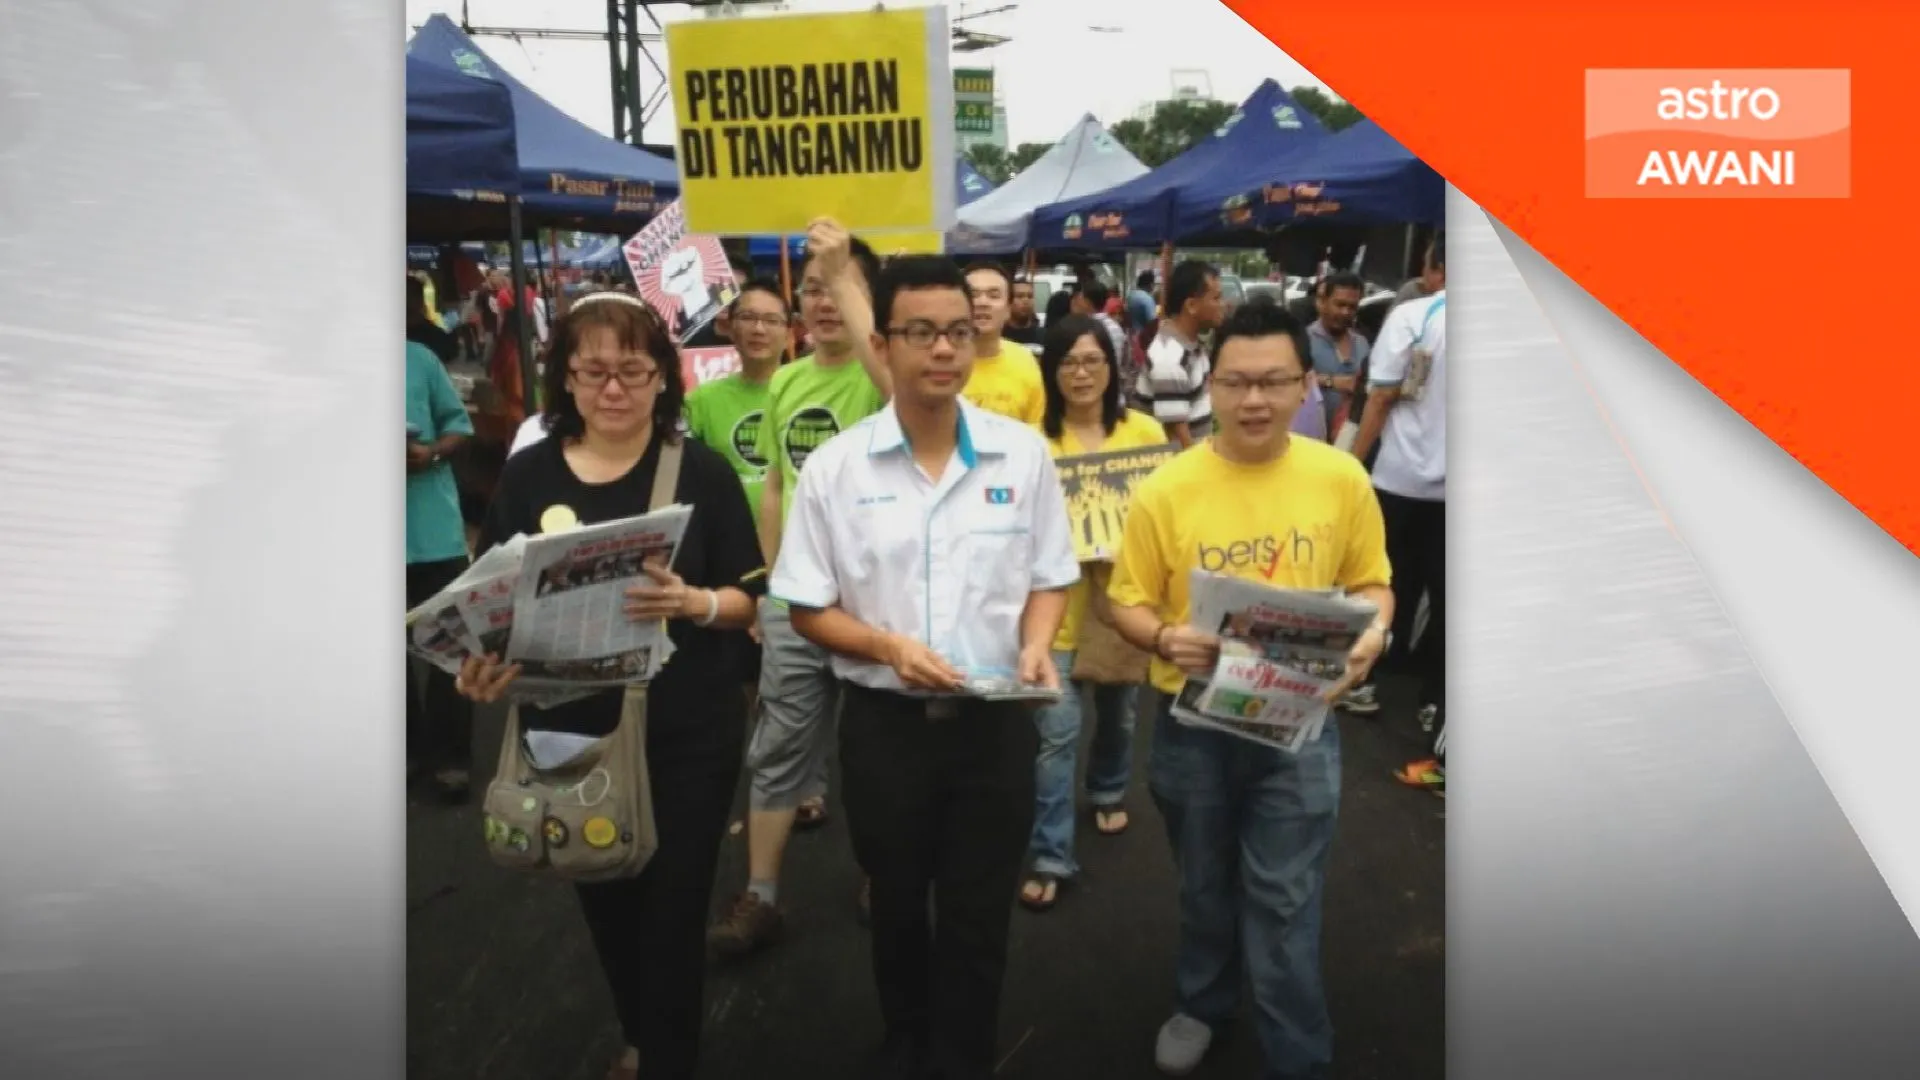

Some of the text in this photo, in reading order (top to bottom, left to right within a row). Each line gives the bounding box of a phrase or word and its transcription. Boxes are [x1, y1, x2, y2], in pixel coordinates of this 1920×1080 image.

[684, 57, 899, 122] PERUBAHAN
[680, 116, 923, 179] DI TANGANMU
[1077, 462, 1102, 477] for
